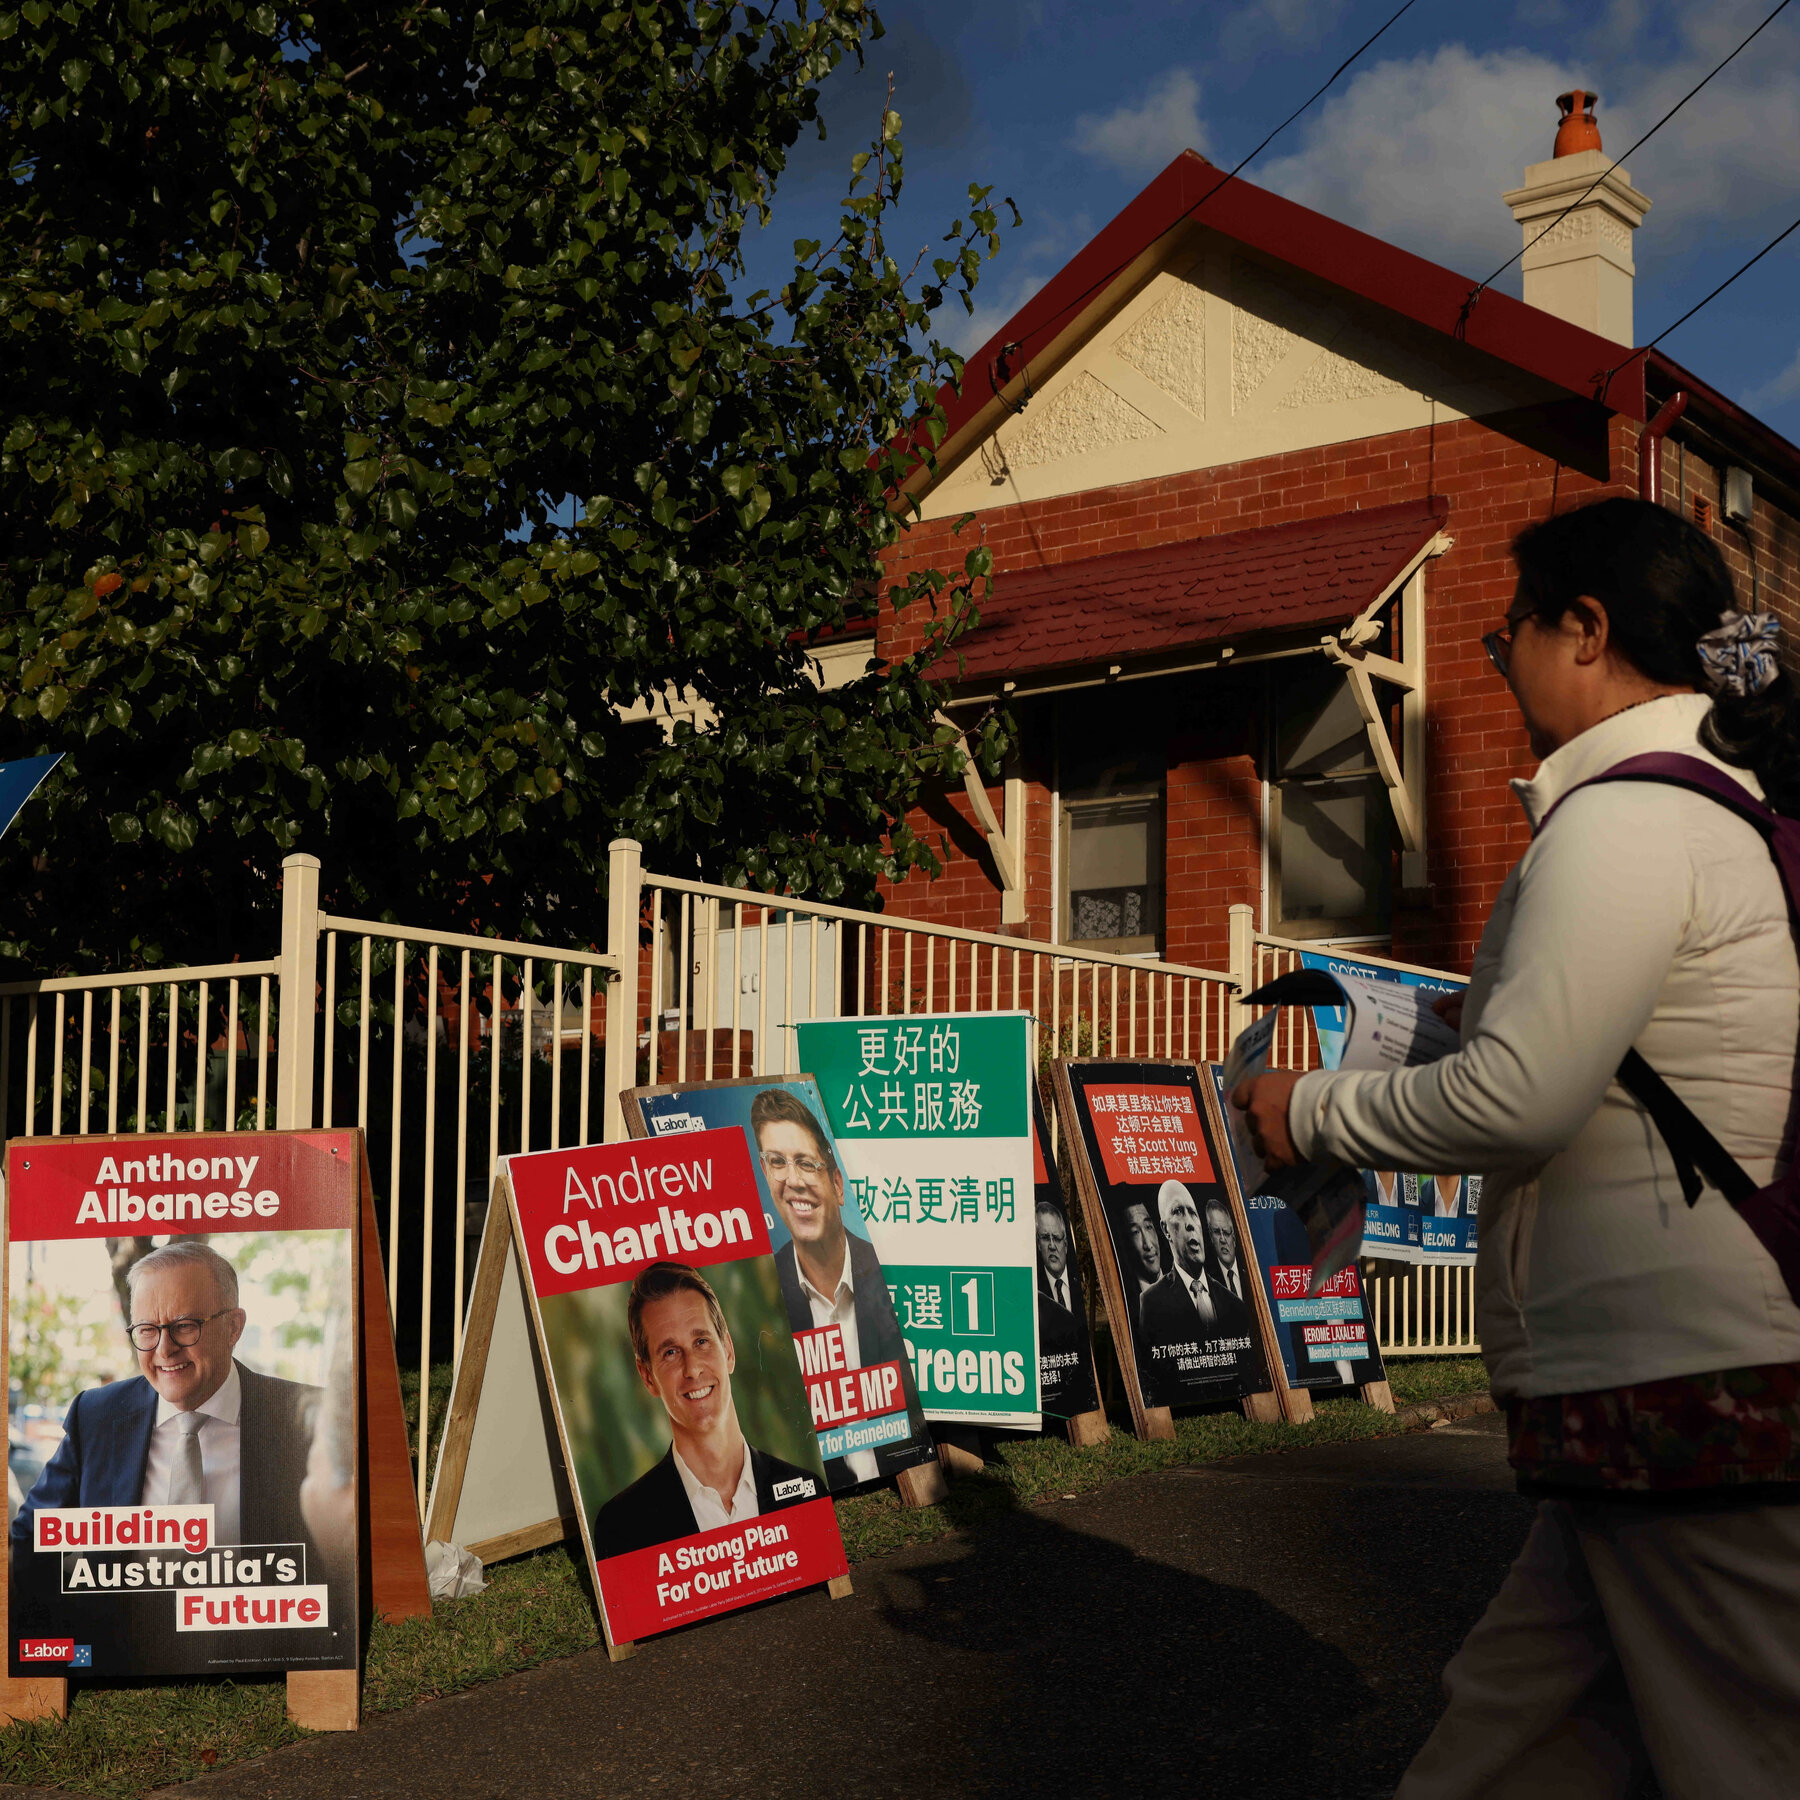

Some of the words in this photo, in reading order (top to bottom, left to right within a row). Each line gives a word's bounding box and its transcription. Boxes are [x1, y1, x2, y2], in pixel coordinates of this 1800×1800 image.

[857, 1023, 960, 1077] 更好的
[842, 1079, 982, 1131] 公共服務
[1091, 1094, 1194, 1114] 如果莫里森让你失望
[656, 1118, 689, 1132] Labor
[1115, 1115, 1184, 1133] 达顿只会更糟
[1111, 1136, 1137, 1154] 支持
[1138, 1138, 1168, 1152] Scott
[1168, 1138, 1197, 1156] Yung
[95, 1153, 260, 1188] Anthony
[1126, 1156, 1195, 1175] 就是支持达顿
[563, 1156, 712, 1214] Andrew
[75, 1188, 279, 1224] Albanese
[544, 1206, 753, 1275] Charlton
[961, 1278, 979, 1330] 1
[1304, 1327, 1331, 1342] JEROME
[1331, 1326, 1355, 1341] LAXALE
[1355, 1325, 1365, 1339] MP
[1309, 1346, 1331, 1359] Member
[1332, 1345, 1340, 1357] for
[1340, 1344, 1368, 1359] Bennelong
[859, 1366, 898, 1413] MP
[826, 1433, 843, 1454] for
[845, 1418, 909, 1449] Bennelong
[776, 1483, 801, 1498] Labor
[39, 1509, 208, 1554] Building
[658, 1552, 675, 1577] A
[675, 1536, 745, 1571] Strong
[744, 1524, 789, 1551] Plan
[68, 1550, 297, 1588] Australia’s
[656, 1581, 692, 1607] For
[693, 1568, 732, 1595] Our
[733, 1550, 799, 1584] Future
[183, 1595, 321, 1626] Future
[24, 1642, 69, 1658] Labor
